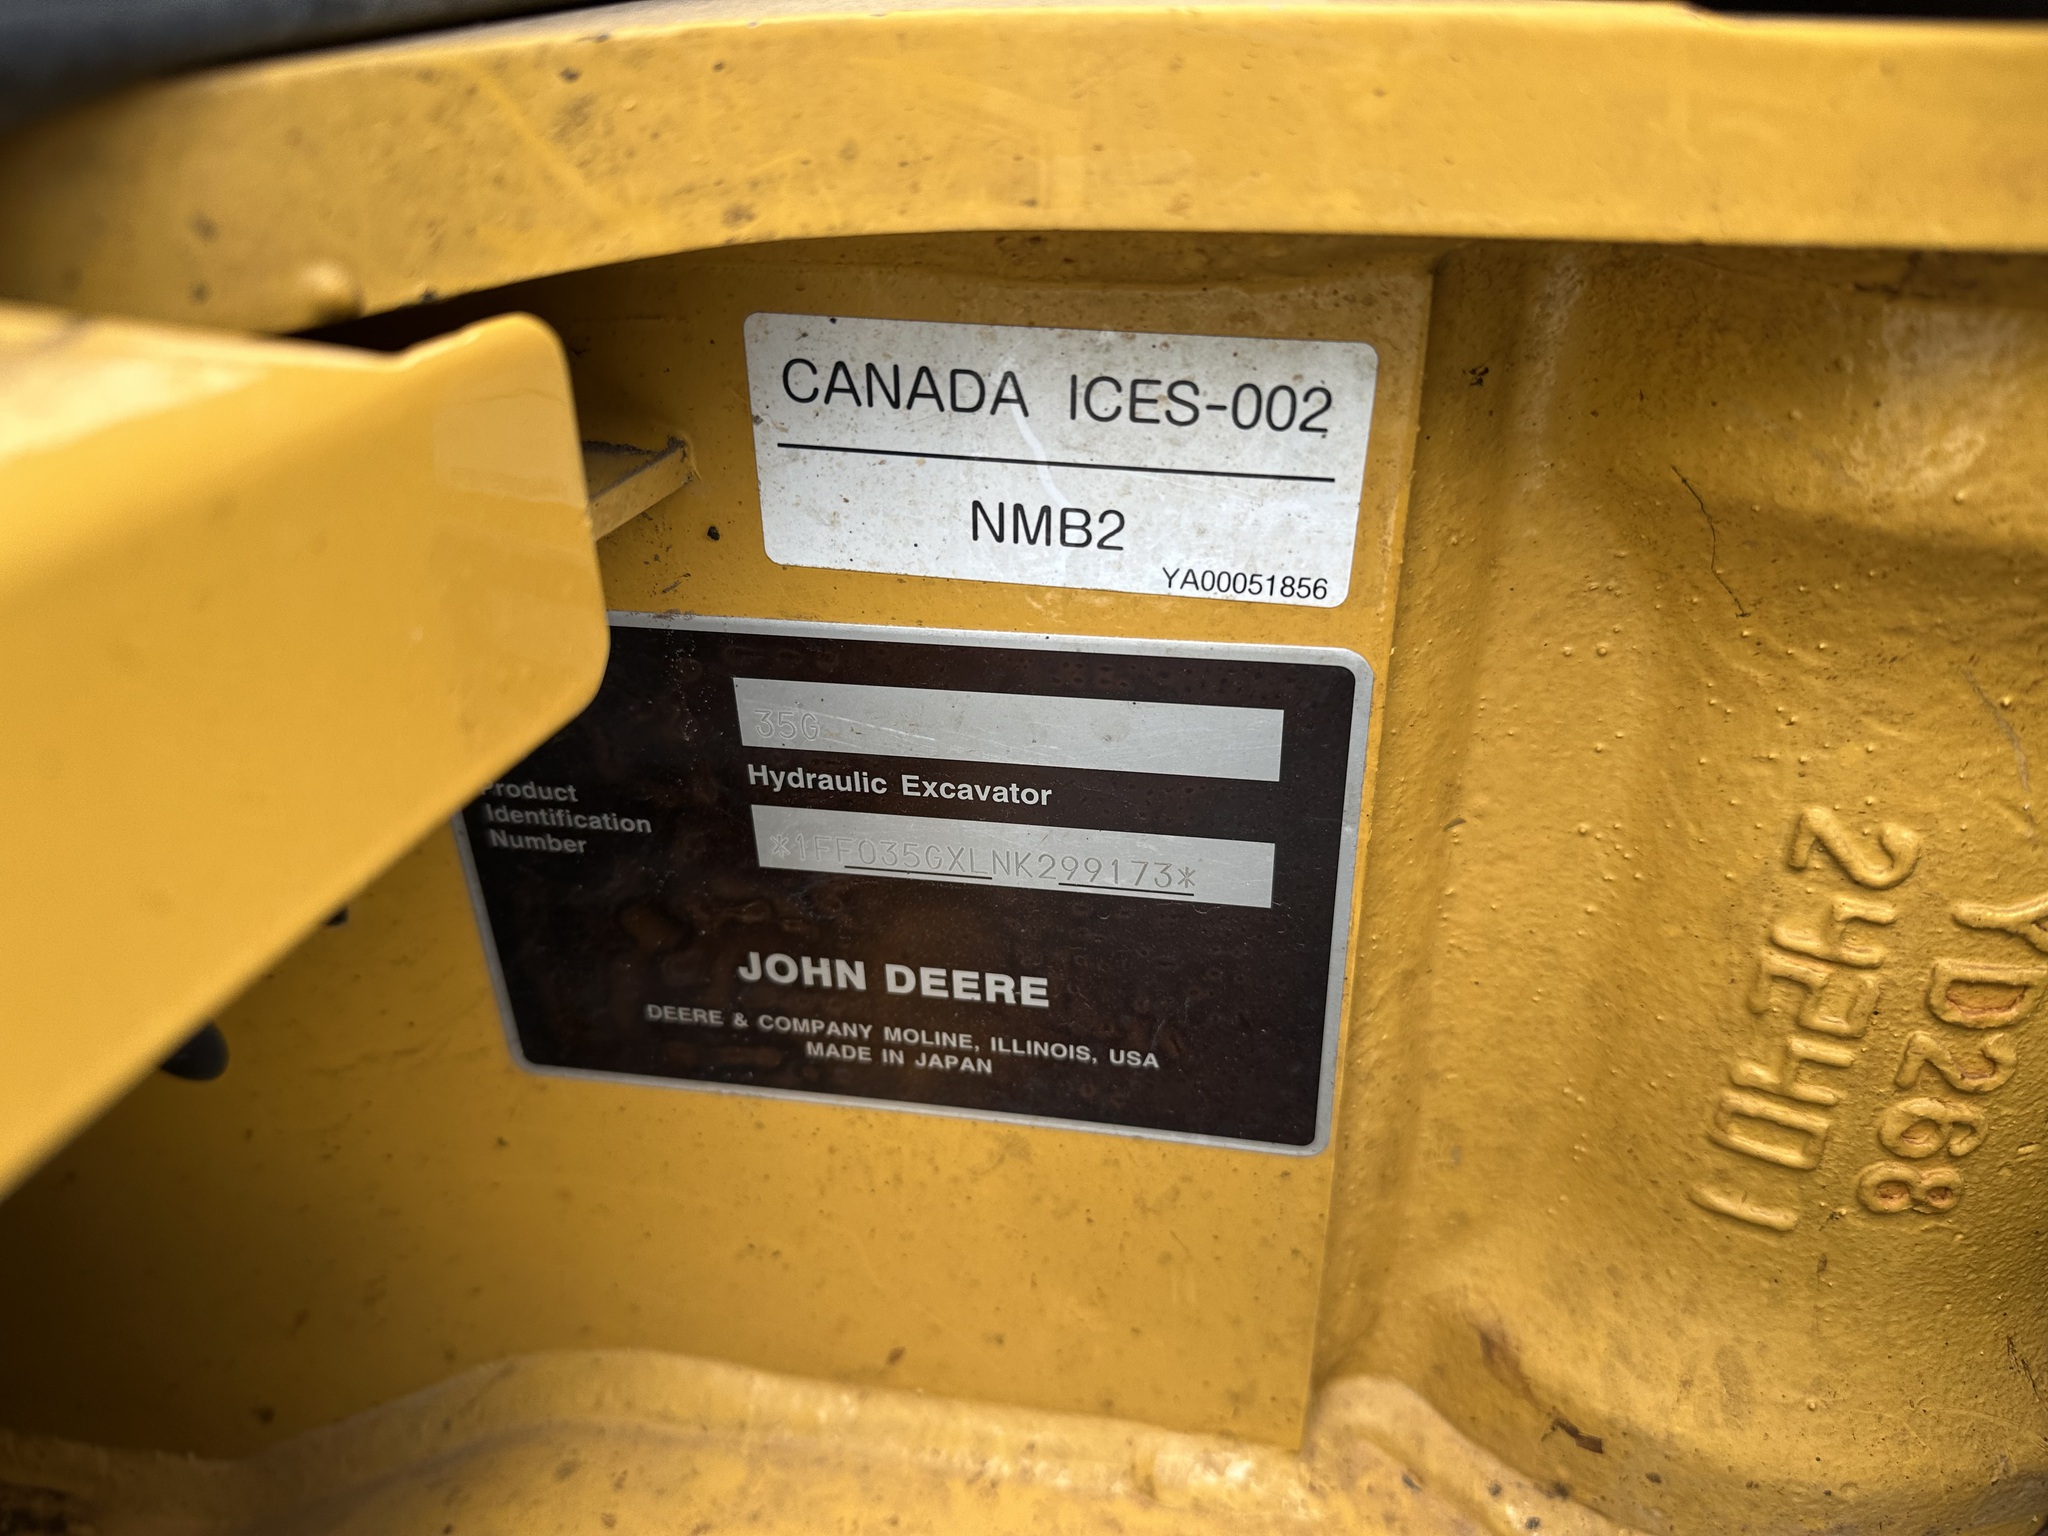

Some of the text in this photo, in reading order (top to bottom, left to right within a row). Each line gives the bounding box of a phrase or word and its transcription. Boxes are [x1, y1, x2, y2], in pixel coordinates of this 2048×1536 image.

[782, 358, 1334, 433] CANADA ICES-002
[972, 500, 1126, 551] NMB2
[1162, 567, 1329, 600] YA00051856
[754, 709, 820, 741] 35G
[748, 764, 1053, 806] Hydraulic Excavator
[485, 803, 652, 833] Identification
[490, 828, 587, 853] Number
[738, 951, 1049, 1007] JOHN DEERE
[646, 1004, 1160, 1069] DEERE & COMPANY MOLINE, ILLINOIS, USA
[806, 1041, 993, 1074] MADE IN JAPAN
